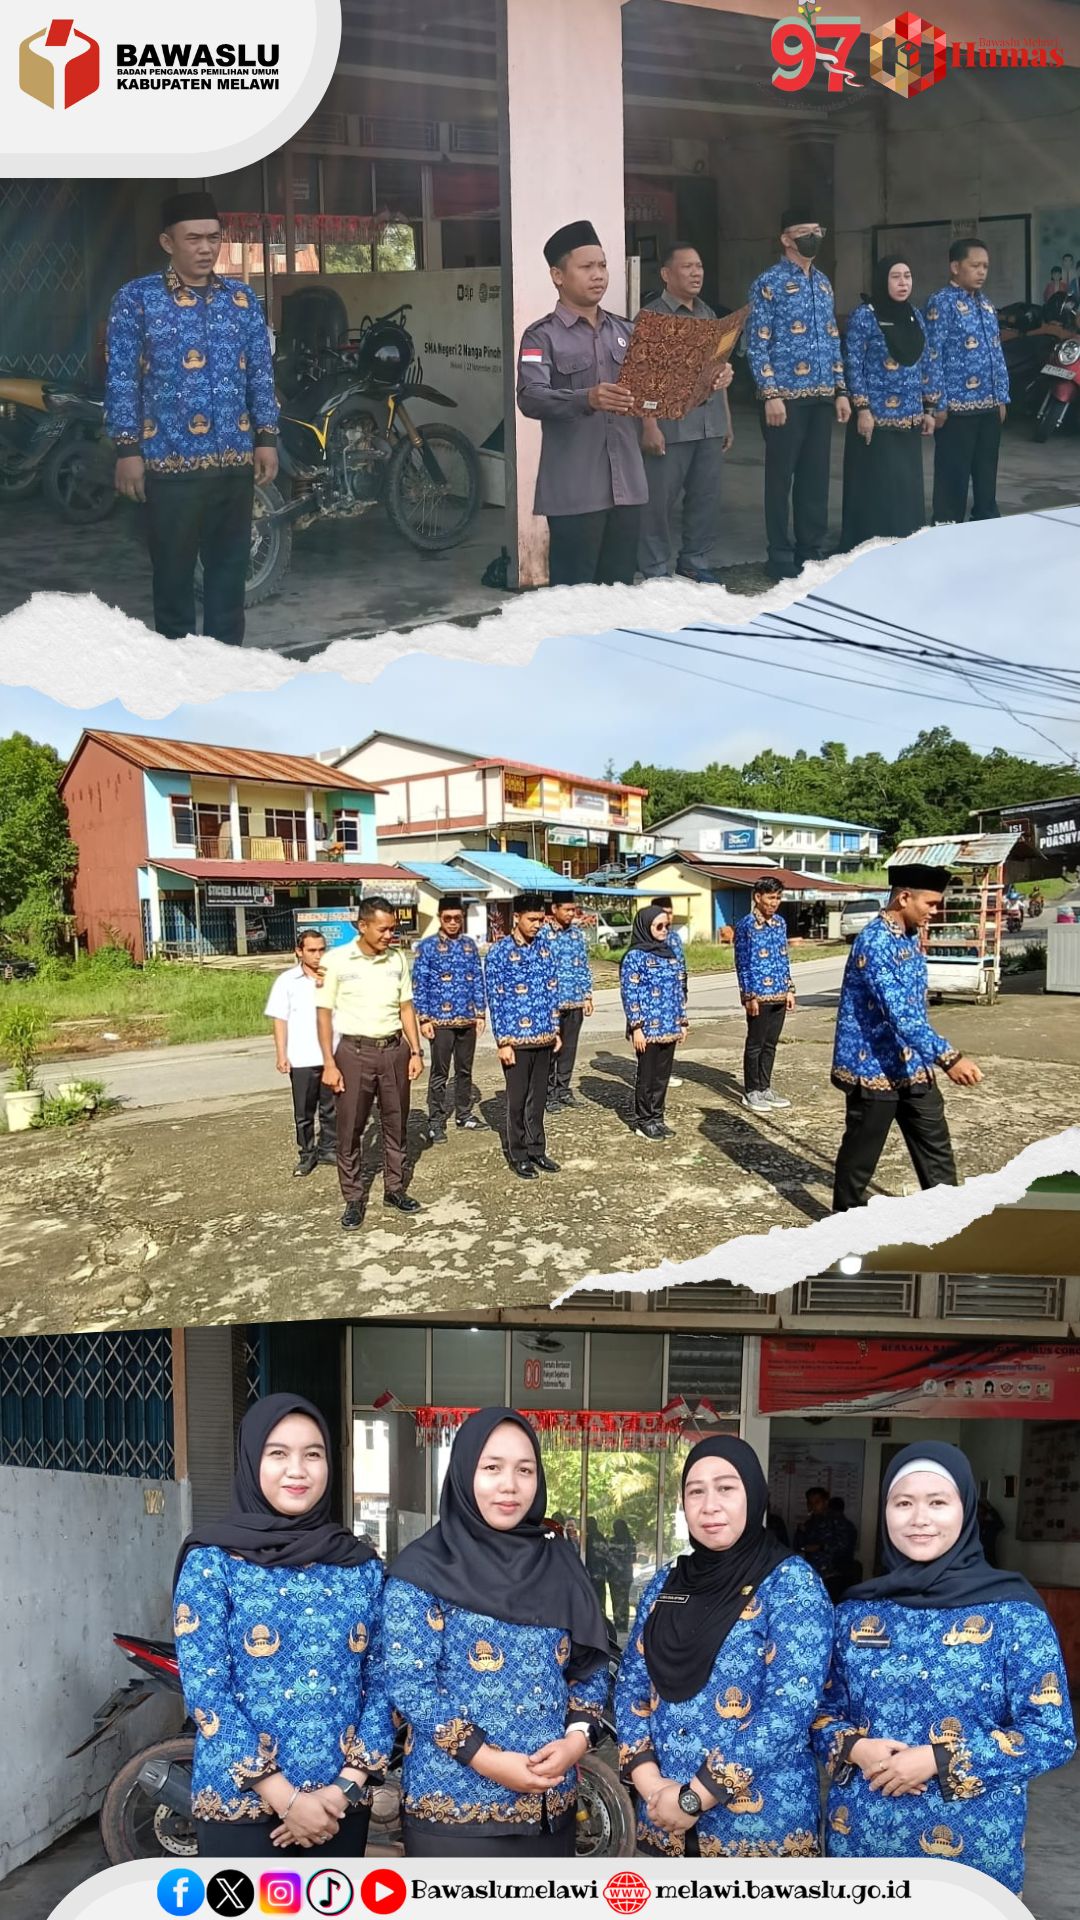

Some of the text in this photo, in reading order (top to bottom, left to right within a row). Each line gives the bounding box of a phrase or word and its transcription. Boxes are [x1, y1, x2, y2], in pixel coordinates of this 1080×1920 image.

[424, 342, 437, 354] SMA
[438, 343, 457, 357] Negeri
[458, 344, 463, 356] 2
[464, 344, 482, 359] Nanga
[1009, 824, 1022, 833] ISI
[1046, 820, 1076, 836] SAMA
[208, 885, 231, 896] STICKER
